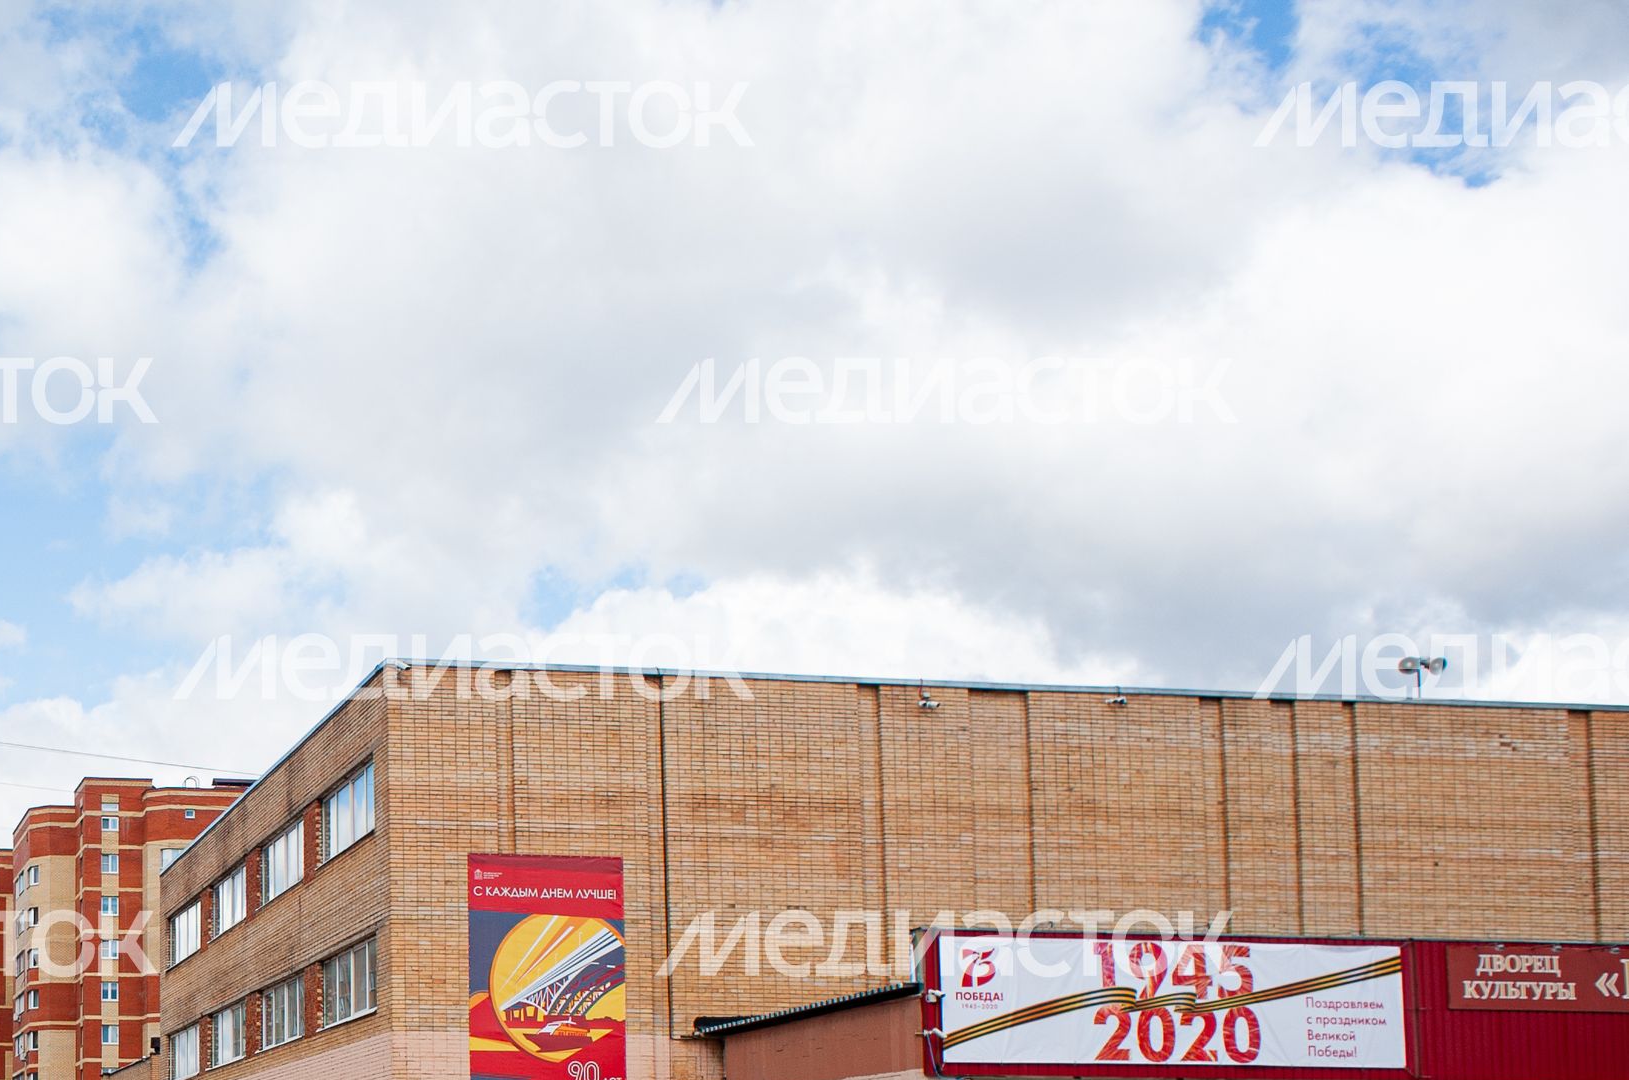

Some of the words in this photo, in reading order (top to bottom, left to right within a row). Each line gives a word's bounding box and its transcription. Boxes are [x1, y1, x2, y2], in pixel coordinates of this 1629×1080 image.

[473, 886, 483, 897] С
[485, 886, 538, 898] КАЖДЫМ
[540, 888, 573, 899] ДНЕМ
[576, 889, 617, 900] ЛУЧШЕ!
[1093, 942, 1253, 1000] 1945
[1475, 954, 1562, 978] ДВОРЕЦ
[955, 991, 1004, 1003] ПОБЕДА!
[1462, 980, 1577, 1001] КУЛЬТУРЫ
[1305, 996, 1384, 1012] Поздравляем
[1306, 1016, 1313, 1025] с
[1315, 1016, 1387, 1028] праздником
[1093, 1003, 1261, 1063] 2020
[1307, 1029, 1356, 1041] Великой
[1308, 1045, 1357, 1059] Победы!
